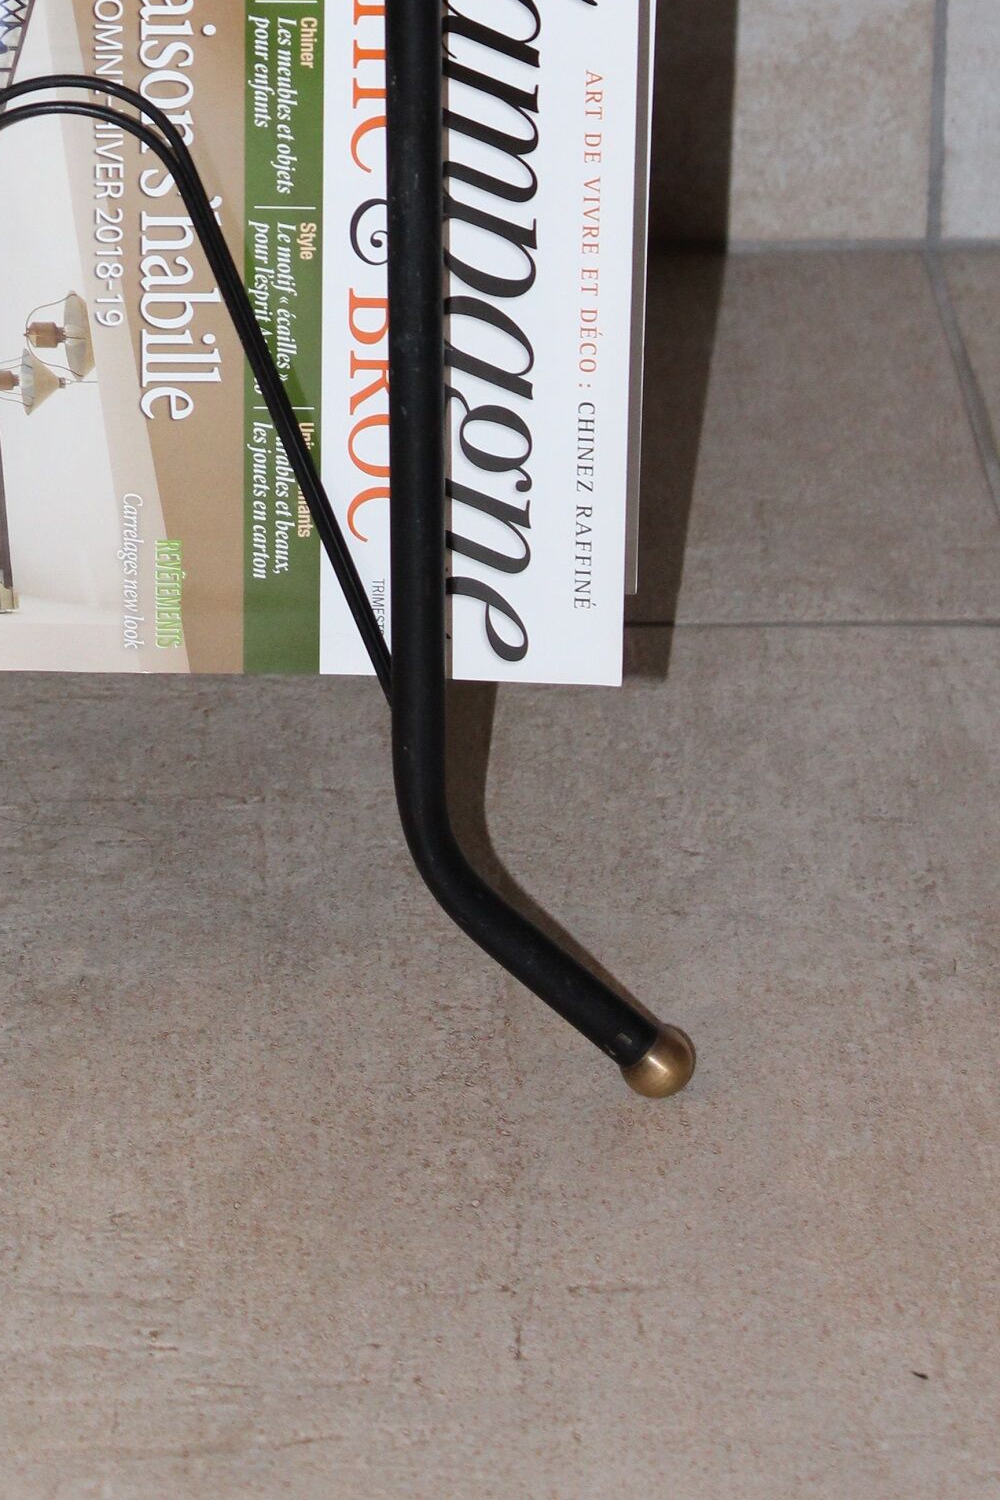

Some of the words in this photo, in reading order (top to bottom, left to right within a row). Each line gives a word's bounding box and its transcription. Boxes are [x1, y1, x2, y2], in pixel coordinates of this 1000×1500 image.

[248, 14, 273, 60] pour
[277, 16, 298, 45] Les
[300, 16, 318, 68] Chiner
[248, 62, 276, 128] enfants
[277, 50, 298, 121] meubles
[585, 69, 604, 120] ART
[276, 124, 295, 140] et
[583, 133, 602, 164] DE
[270, 143, 297, 195] objets
[248, 218, 273, 263] pour
[276, 221, 297, 241] Le
[297, 221, 317, 260] Style
[582, 177, 602, 255] VIVRE
[94, 206, 124, 327] 2018-19
[271, 245, 298, 294] motif
[580, 268, 599, 297] ET
[248, 266, 275, 323] l'esprit
[276, 308, 297, 369] écailles
[580, 308, 603, 374] DÉCO
[253, 421, 273, 443] les
[577, 401, 597, 493] CHINEZ
[248, 443, 272, 499] jouets
[117, 492, 144, 576] Carrelages
[253, 501, 268, 521] en
[274, 501, 293, 518] et
[252, 525, 270, 580] carton
[271, 520, 296, 574] beaux,
[573, 504, 597, 611] RAFFINÉ
[123, 579, 137, 612] new
[154, 539, 187, 650] REVÊTEMENTS
[123, 614, 145, 650] look
